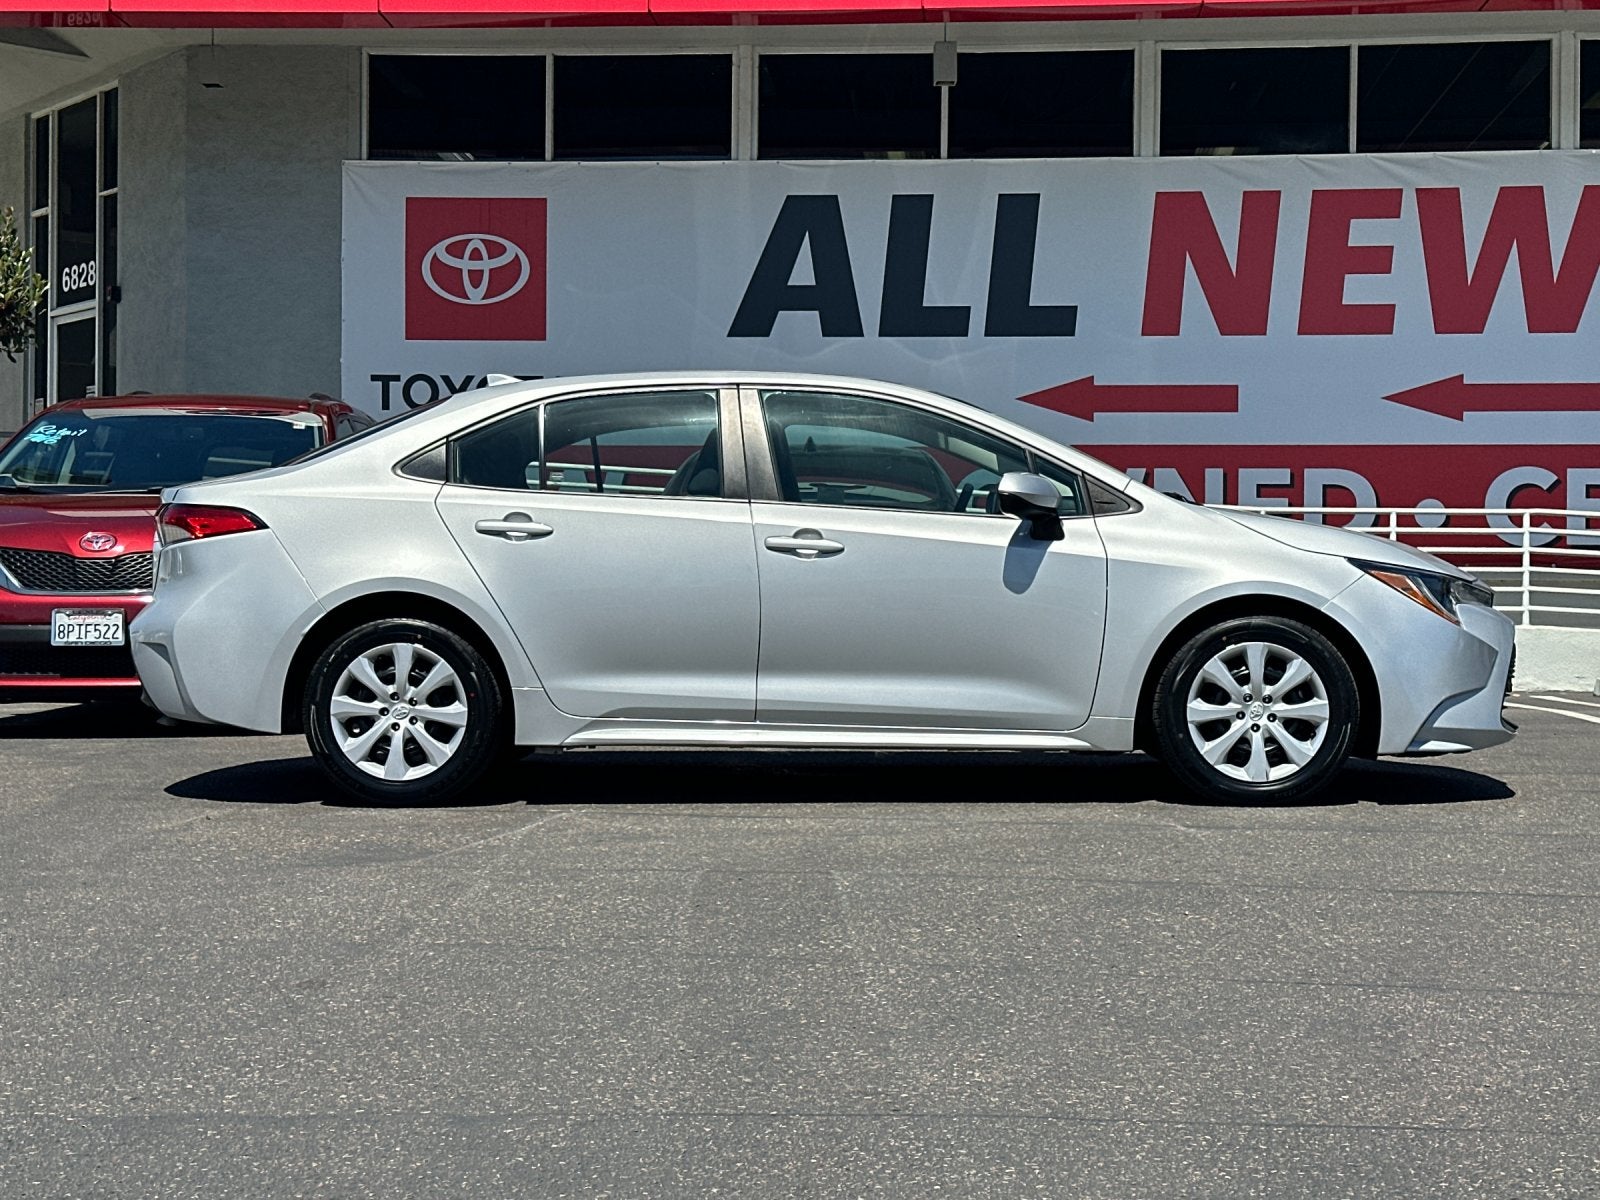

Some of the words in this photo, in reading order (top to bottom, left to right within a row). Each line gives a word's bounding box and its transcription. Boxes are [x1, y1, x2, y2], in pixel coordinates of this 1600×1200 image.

[62, 260, 96, 293] 6828
[727, 192, 1078, 338] ALL
[1141, 184, 1600, 336] NEW
[370, 373, 562, 411] TOY
[57, 623, 120, 640] 8PIF522
